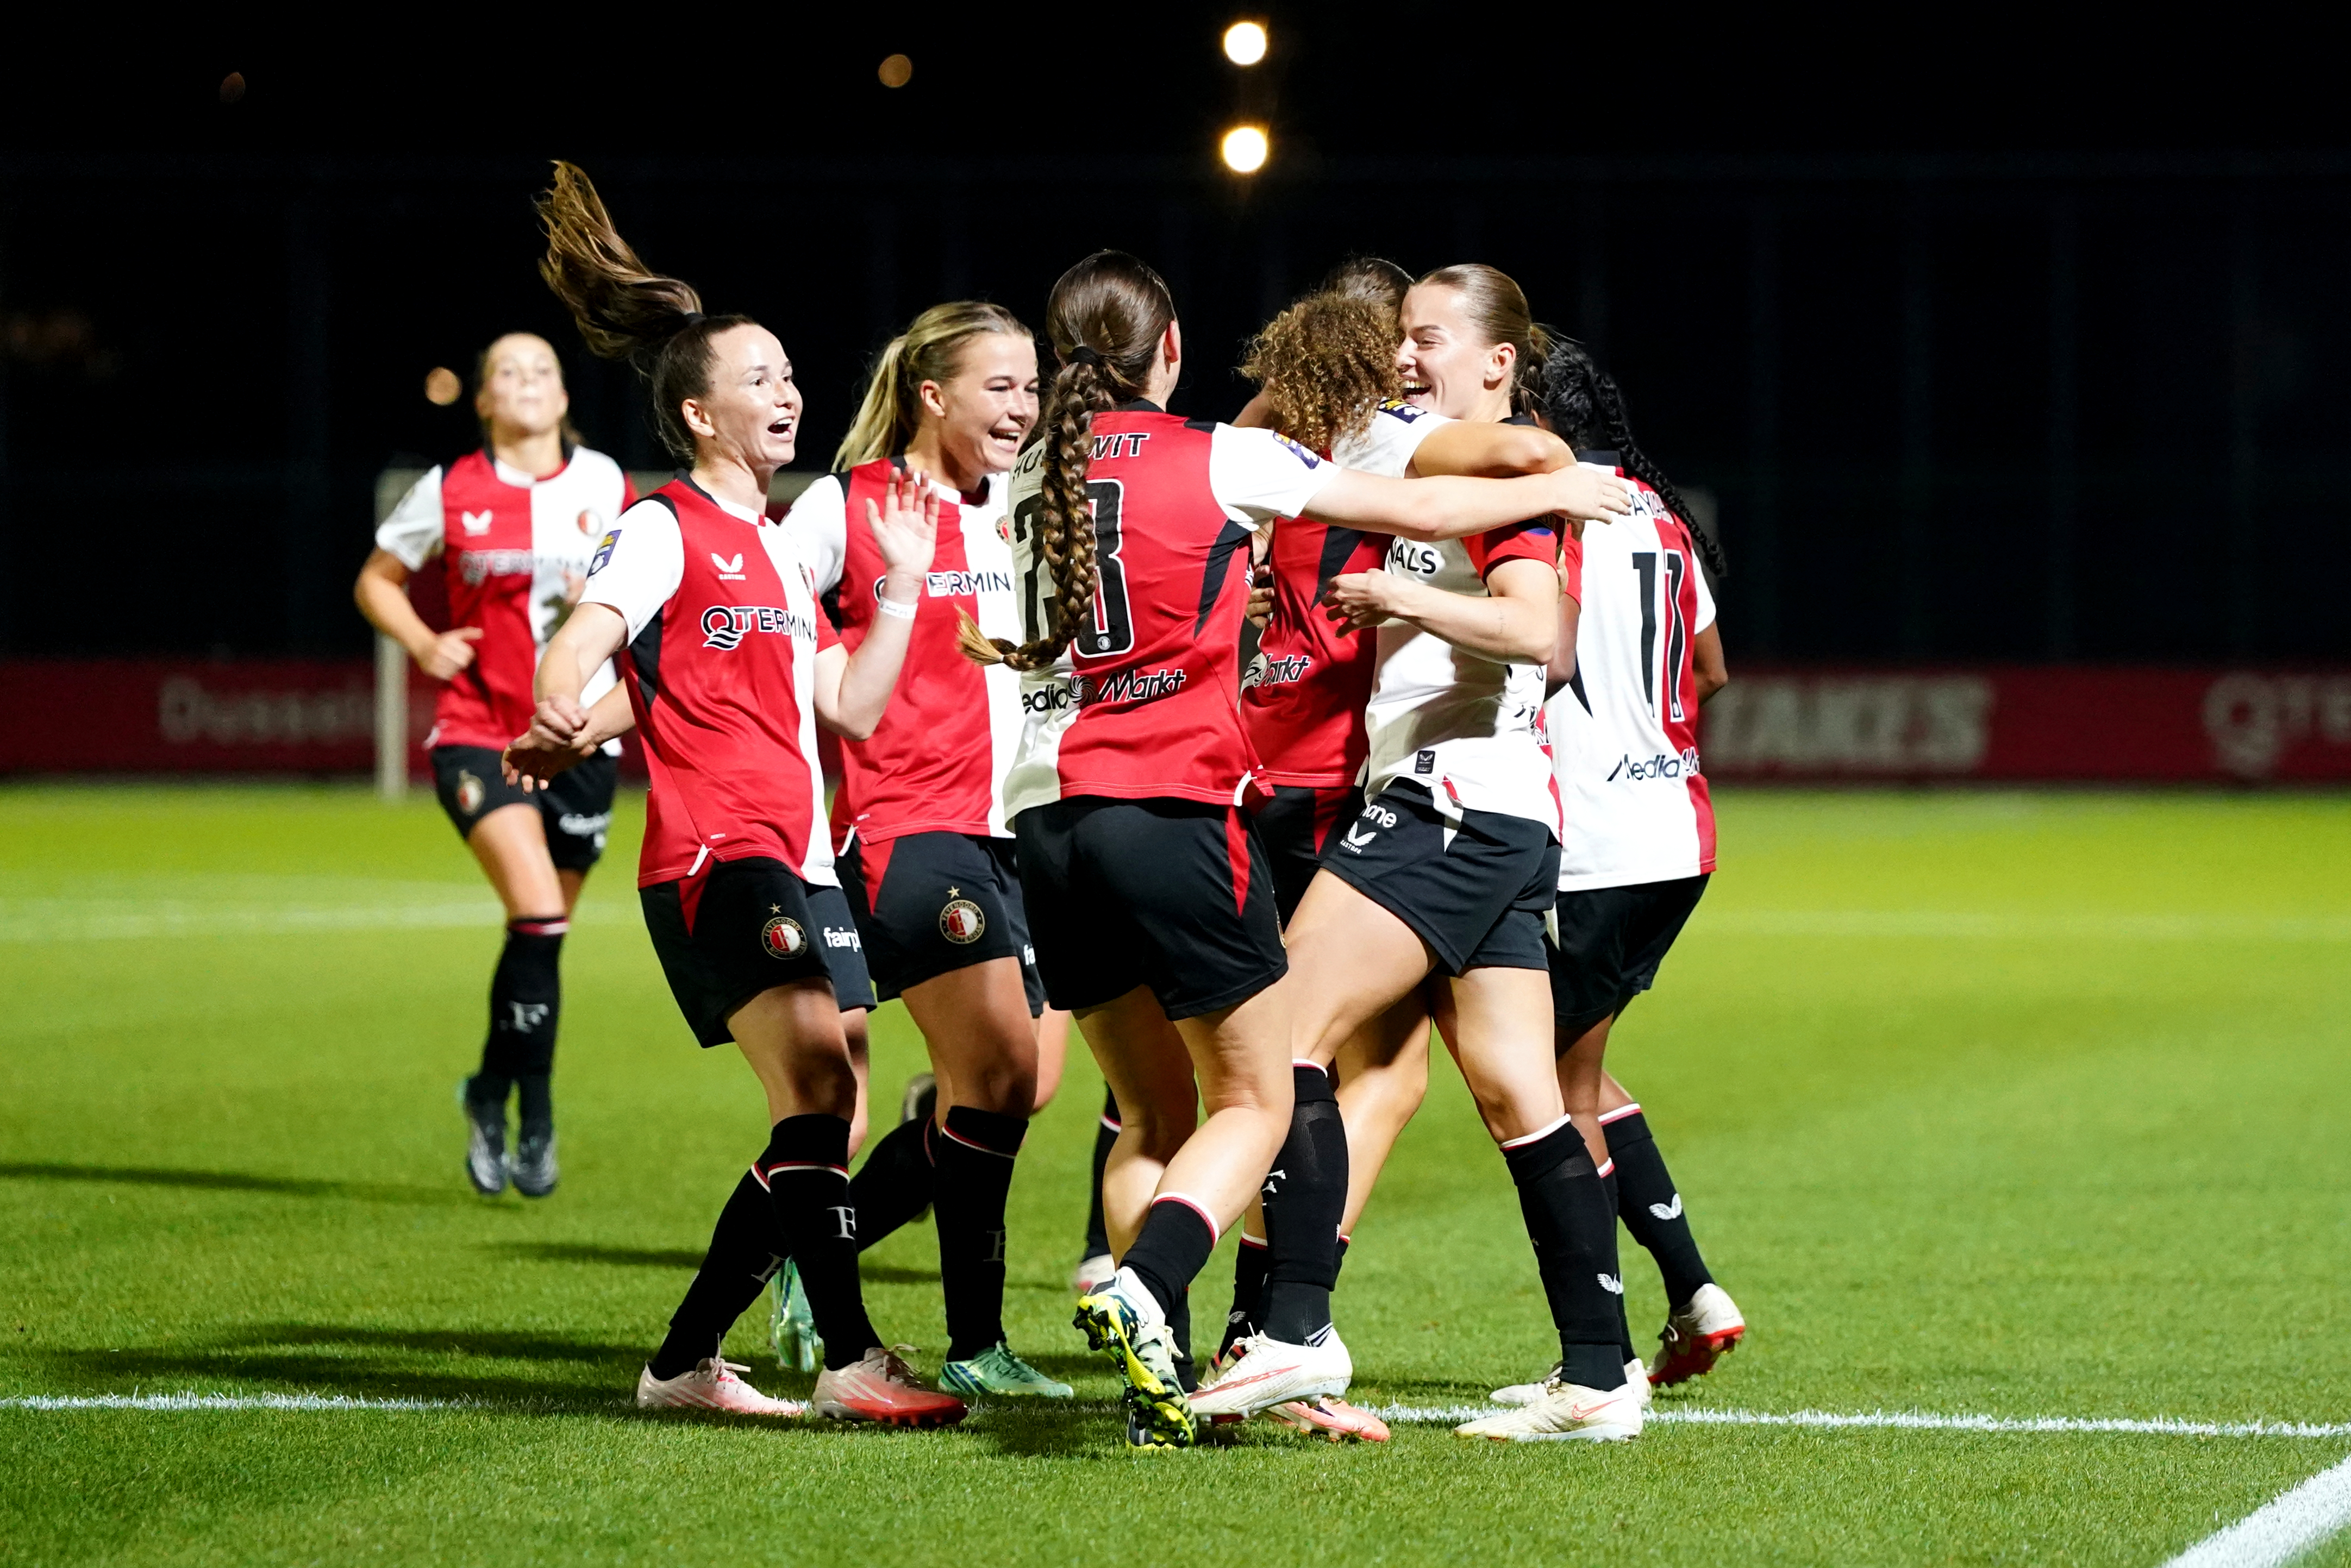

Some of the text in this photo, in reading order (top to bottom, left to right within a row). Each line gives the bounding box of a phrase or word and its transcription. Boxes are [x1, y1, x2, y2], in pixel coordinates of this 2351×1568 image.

[1632, 549, 1685, 723] 11
[1022, 668, 1187, 714] edia Markt
[1606, 754, 1680, 782] Media
